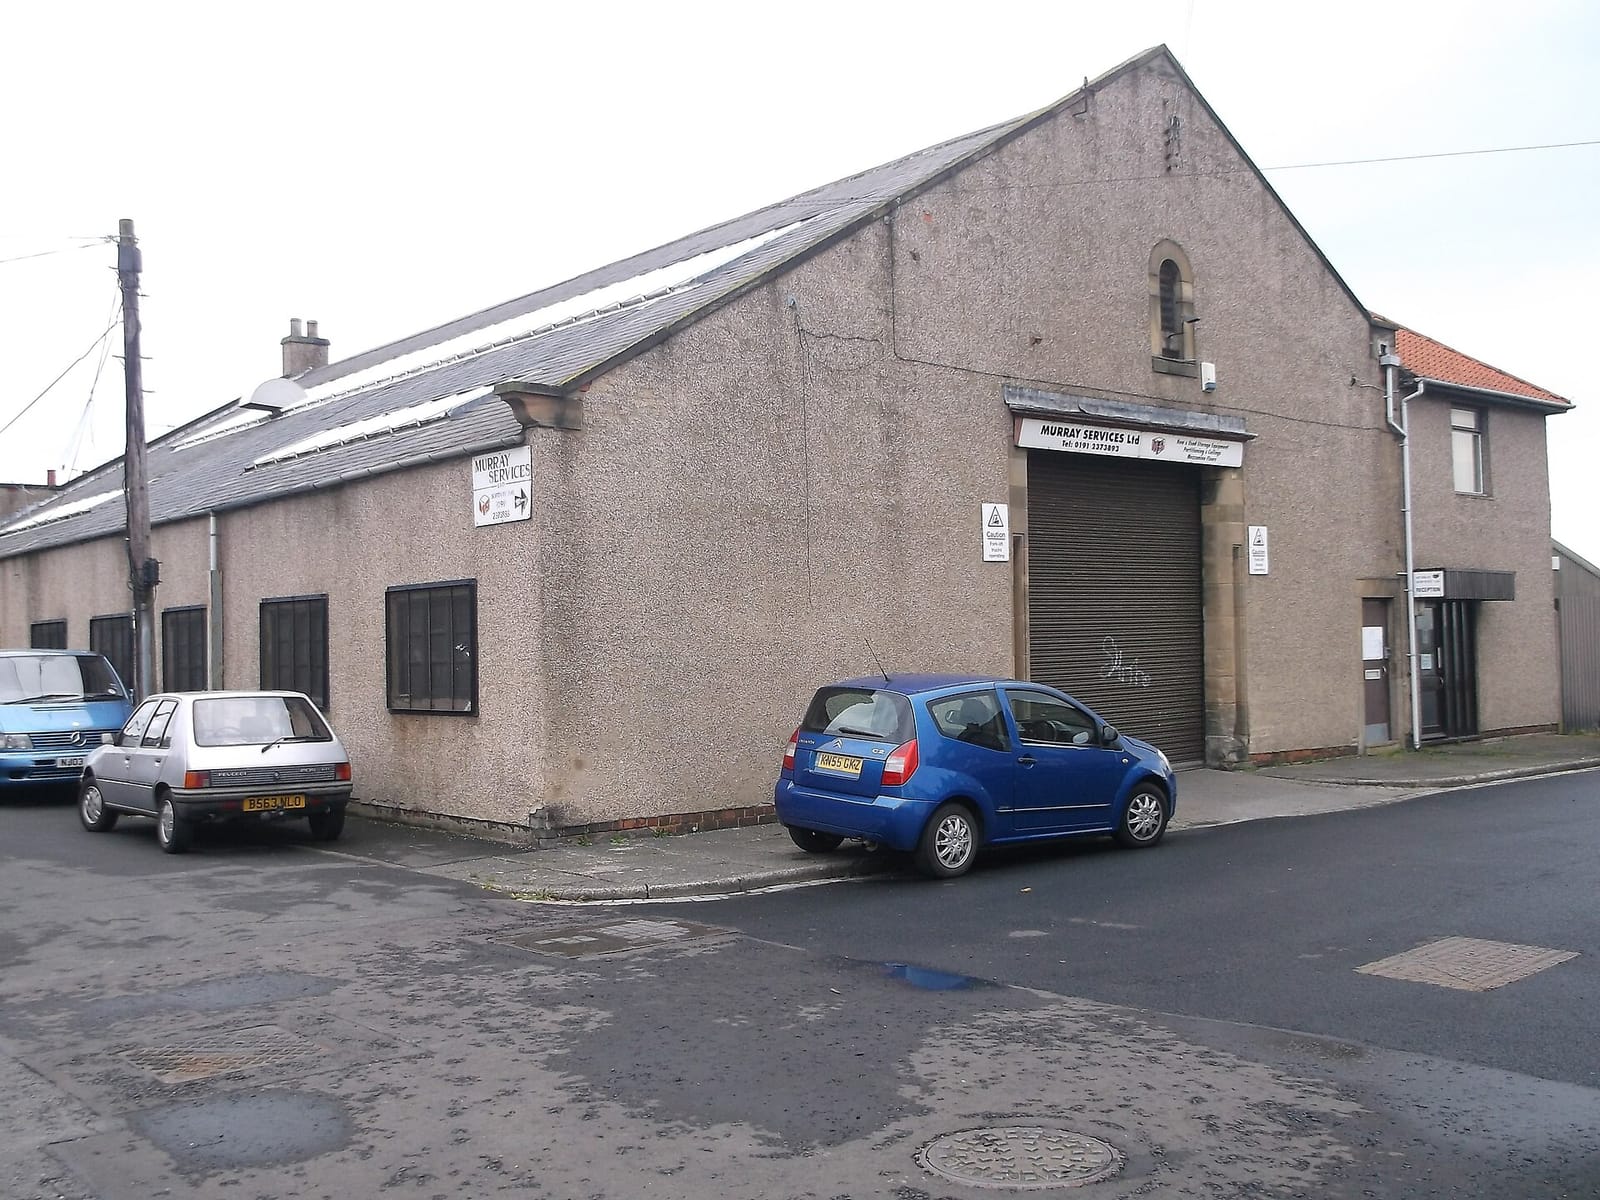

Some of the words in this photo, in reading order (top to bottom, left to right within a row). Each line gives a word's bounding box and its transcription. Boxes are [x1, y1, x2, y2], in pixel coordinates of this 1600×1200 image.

[1040, 425, 1081, 439] MURRAY
[1083, 429, 1125, 443] SERVICES
[1127, 434, 1140, 445] Ltd
[1062, 440, 1073, 448] Tel:
[1074, 441, 1090, 449] 0191
[474, 453, 511, 473] MURRAY
[488, 463, 530, 483] SERVICES
